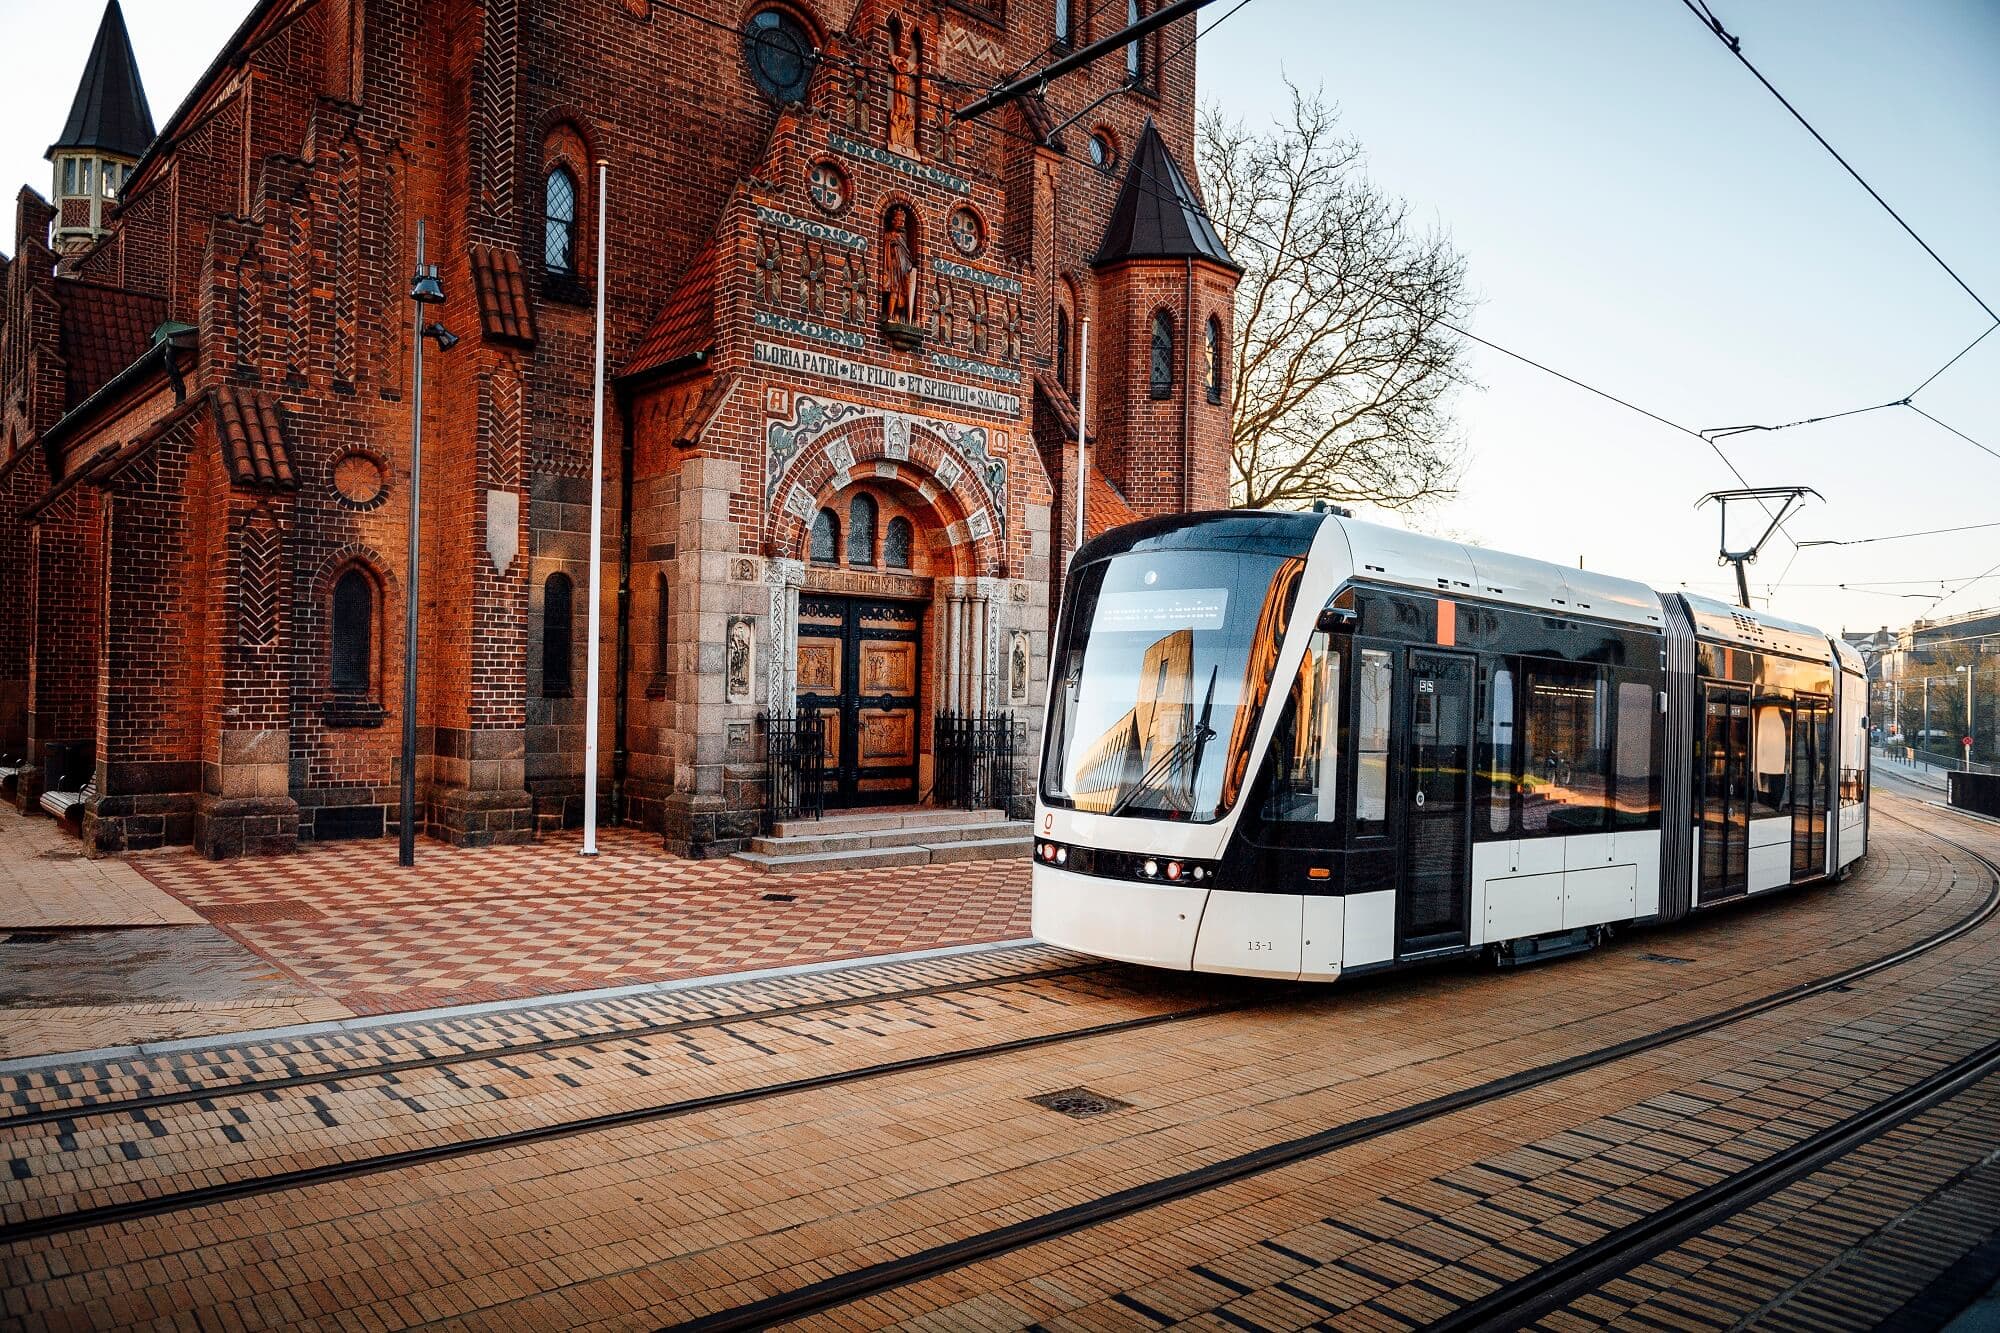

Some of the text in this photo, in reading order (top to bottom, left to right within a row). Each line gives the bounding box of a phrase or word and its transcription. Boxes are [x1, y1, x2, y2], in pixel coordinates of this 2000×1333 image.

[802, 353, 840, 376] PATRI
[849, 363, 865, 381] ET
[866, 366, 896, 388] FILIO
[907, 375, 923, 393] ET
[924, 379, 969, 402] SPIRITUI
[1248, 941, 1273, 951] 13-1
